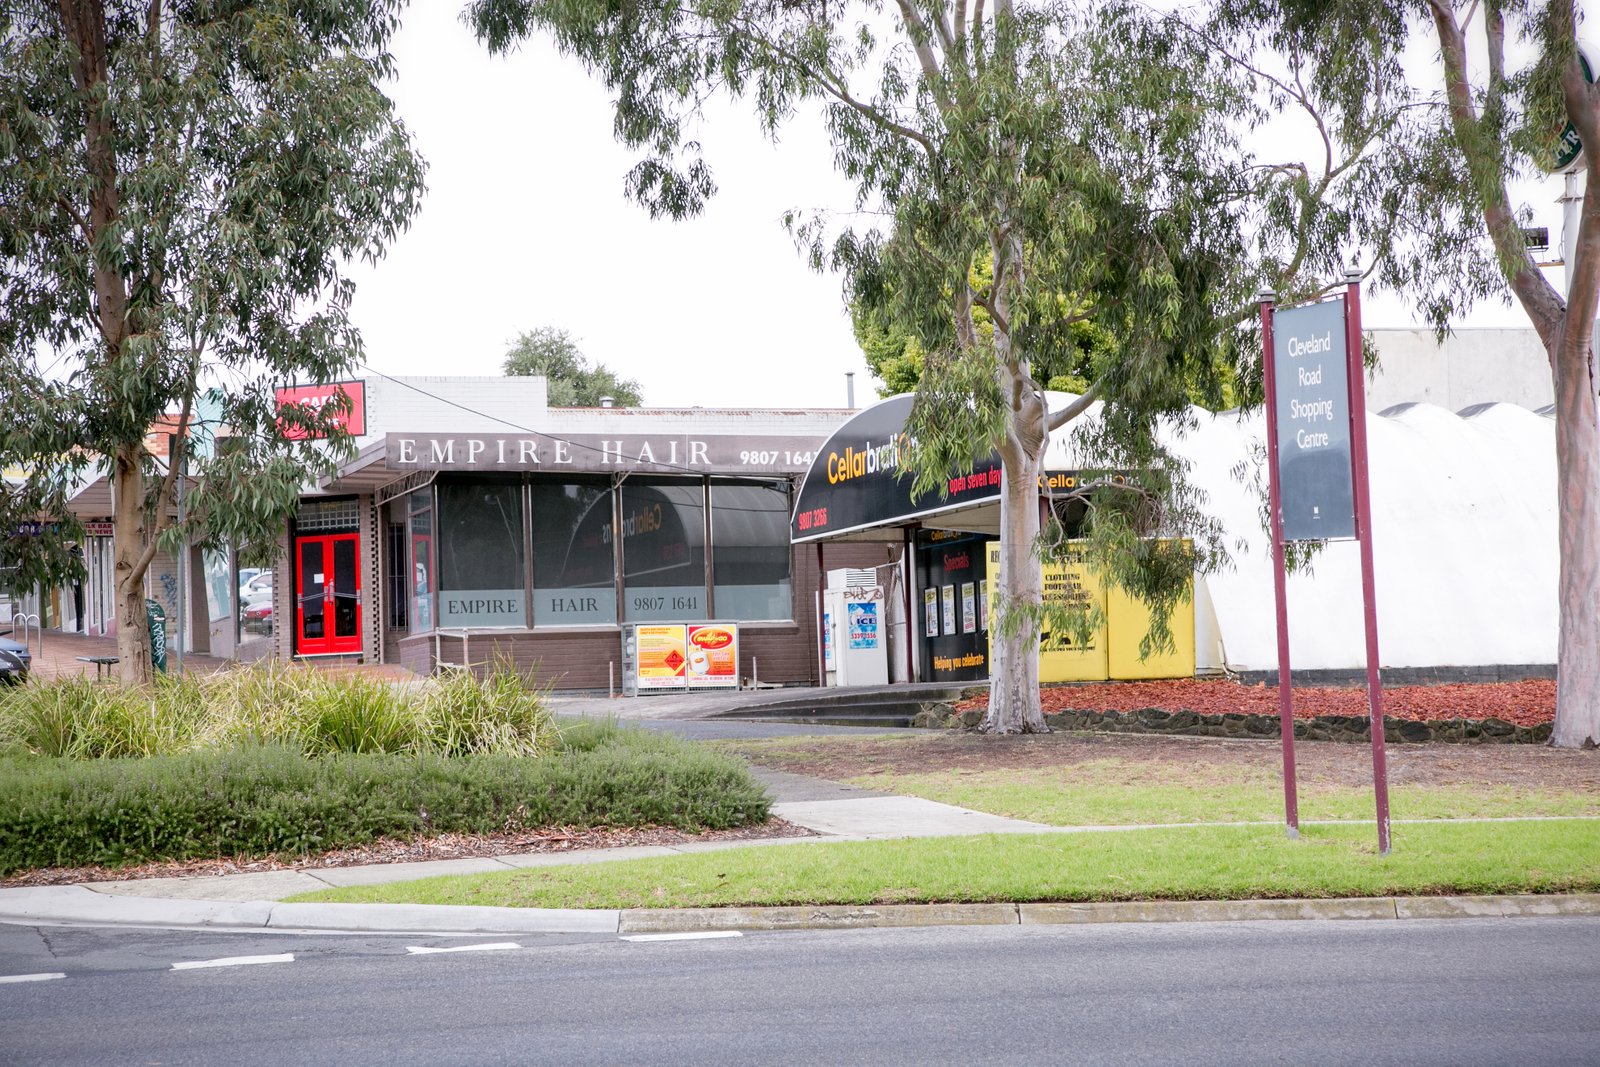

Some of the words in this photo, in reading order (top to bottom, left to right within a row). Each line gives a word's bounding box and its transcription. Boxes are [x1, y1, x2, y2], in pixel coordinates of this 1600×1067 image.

[1288, 331, 1331, 357] Cleveland
[1298, 364, 1322, 387] Road
[1290, 397, 1333, 423] Shopping
[1296, 429, 1329, 449] Centre
[398, 439, 573, 464] EMPIRE
[601, 440, 712, 465] HAIR
[740, 450, 779, 465] 9807
[949, 477, 966, 496] open
[967, 472, 988, 488] seven
[798, 511, 813, 531] 9807
[813, 507, 827, 528] 3266
[943, 551, 970, 575] Specials
[1045, 573, 1080, 581] CLOTHING
[448, 599, 519, 615] EMPIRE
[551, 598, 600, 613] HAIR
[633, 597, 665, 612] 9807
[671, 596, 698, 611] 1641
[934, 655, 953, 672] Helping
[952, 657, 962, 671] you
[962, 652, 985, 668] celebrate
